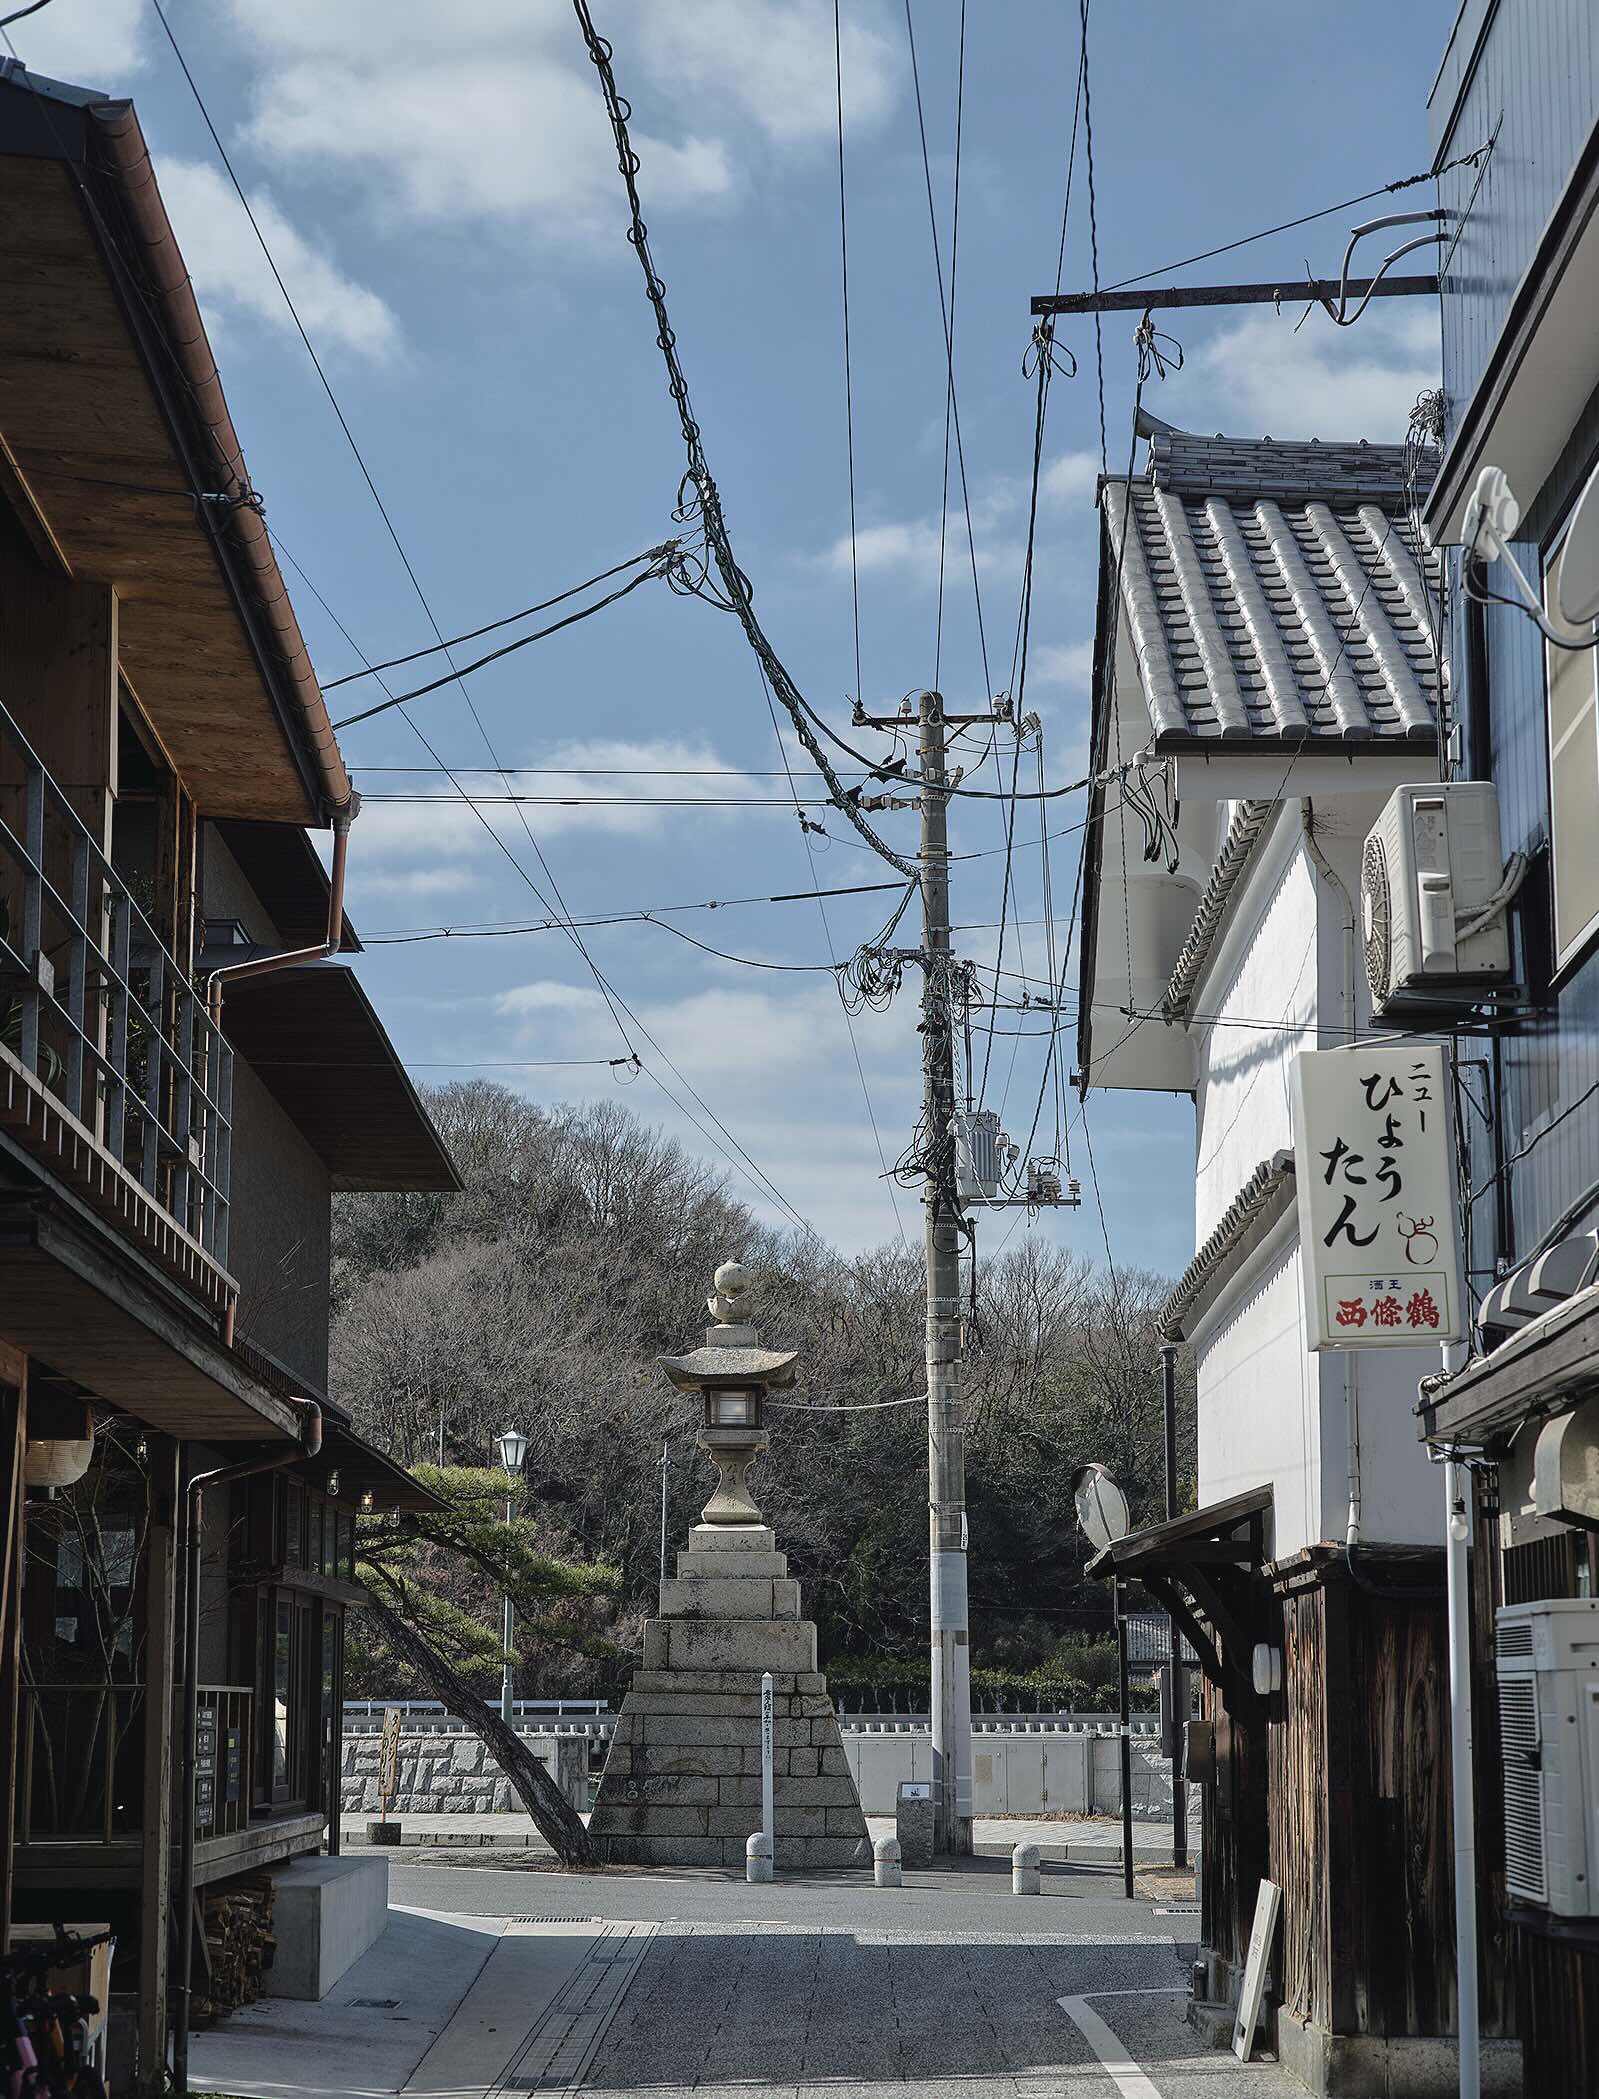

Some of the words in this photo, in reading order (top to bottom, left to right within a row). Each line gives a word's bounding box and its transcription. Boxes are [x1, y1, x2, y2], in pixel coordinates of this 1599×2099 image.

[1407, 1063, 1433, 1133] ニュー
[1359, 1073, 1404, 1202] ひょう
[1319, 1136, 1381, 1248] たん
[1336, 1288, 1440, 1328] 西條鶴
[387, 1713, 399, 1777] タクシー
